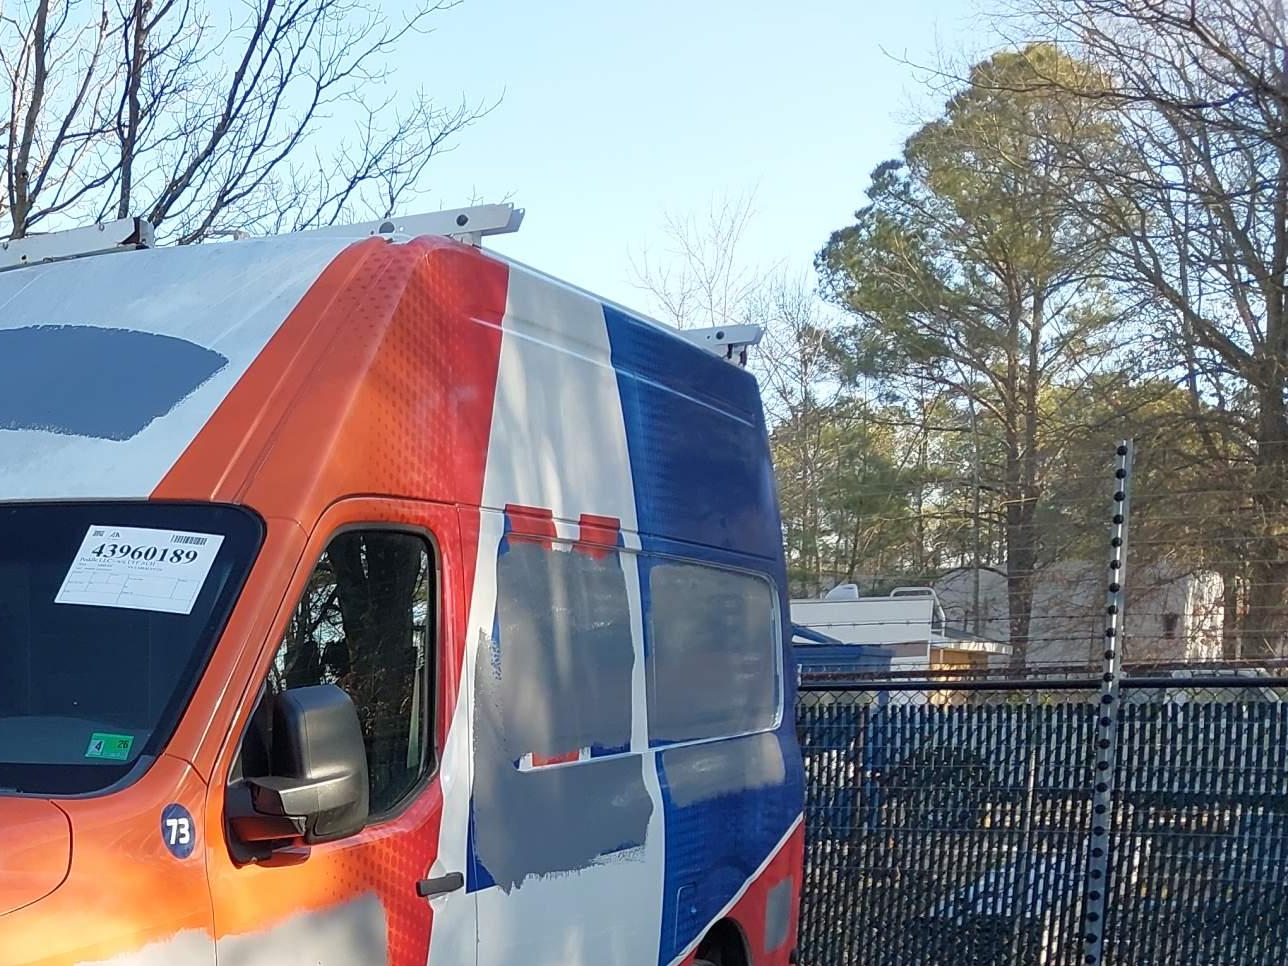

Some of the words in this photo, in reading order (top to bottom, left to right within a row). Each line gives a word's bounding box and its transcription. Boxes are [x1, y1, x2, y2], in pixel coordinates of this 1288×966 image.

[91, 543, 198, 566] 43960189
[94, 740, 102, 751] 4
[117, 739, 130, 749] 26
[166, 817, 191, 845] 73
